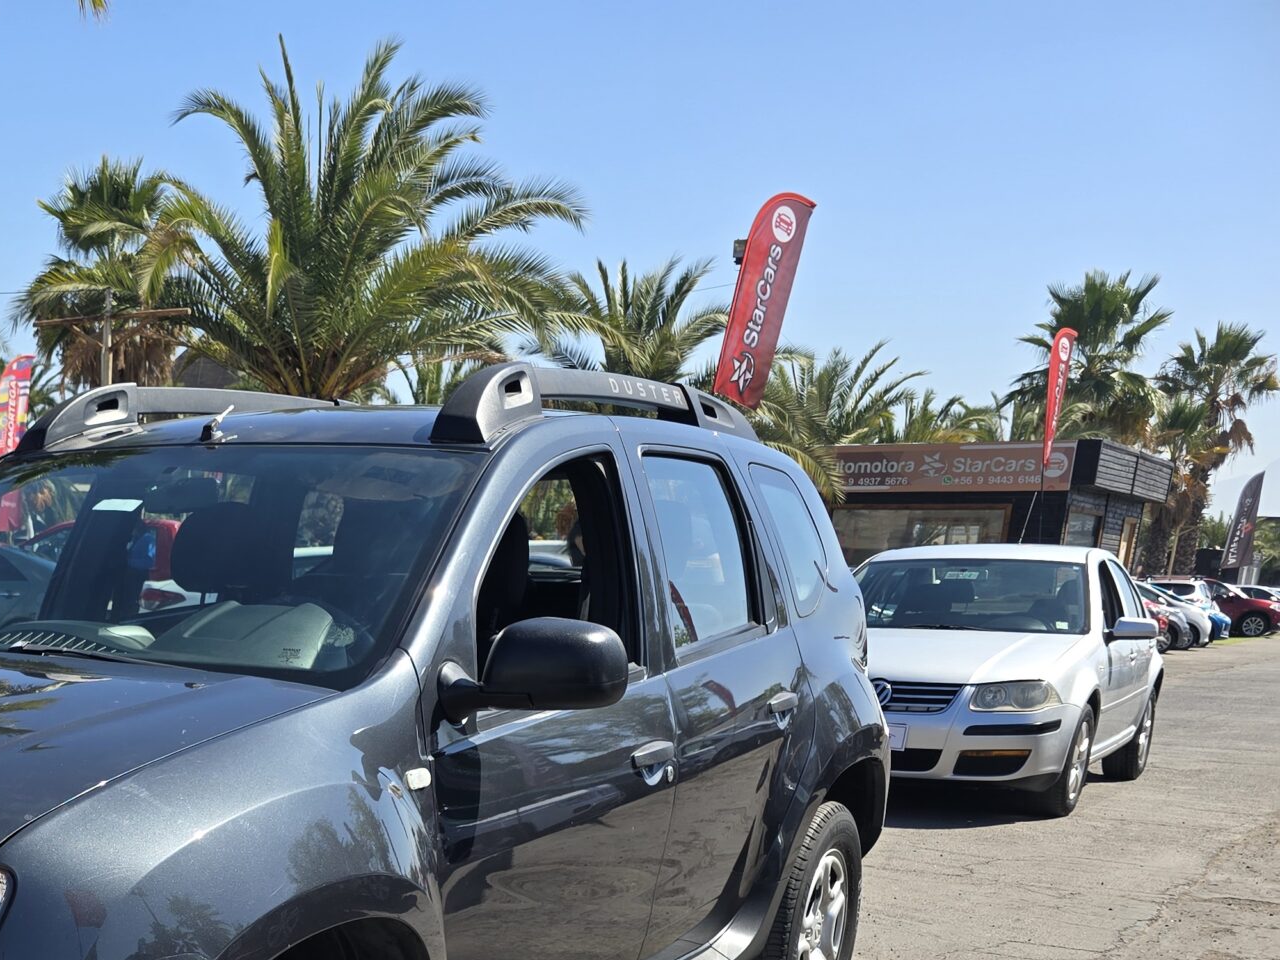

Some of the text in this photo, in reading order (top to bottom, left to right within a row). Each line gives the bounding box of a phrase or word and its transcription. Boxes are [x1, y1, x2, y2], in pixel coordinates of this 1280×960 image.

[743, 243, 783, 349] StarCars
[609, 377, 683, 405] DUSTER
[836, 456, 1036, 474] tomotora StarCars
[858, 477, 881, 486] 4937
[885, 477, 908, 485] 5676
[977, 476, 984, 485] 9
[988, 476, 1013, 485] 9443
[1018, 474, 1041, 484] 6146
